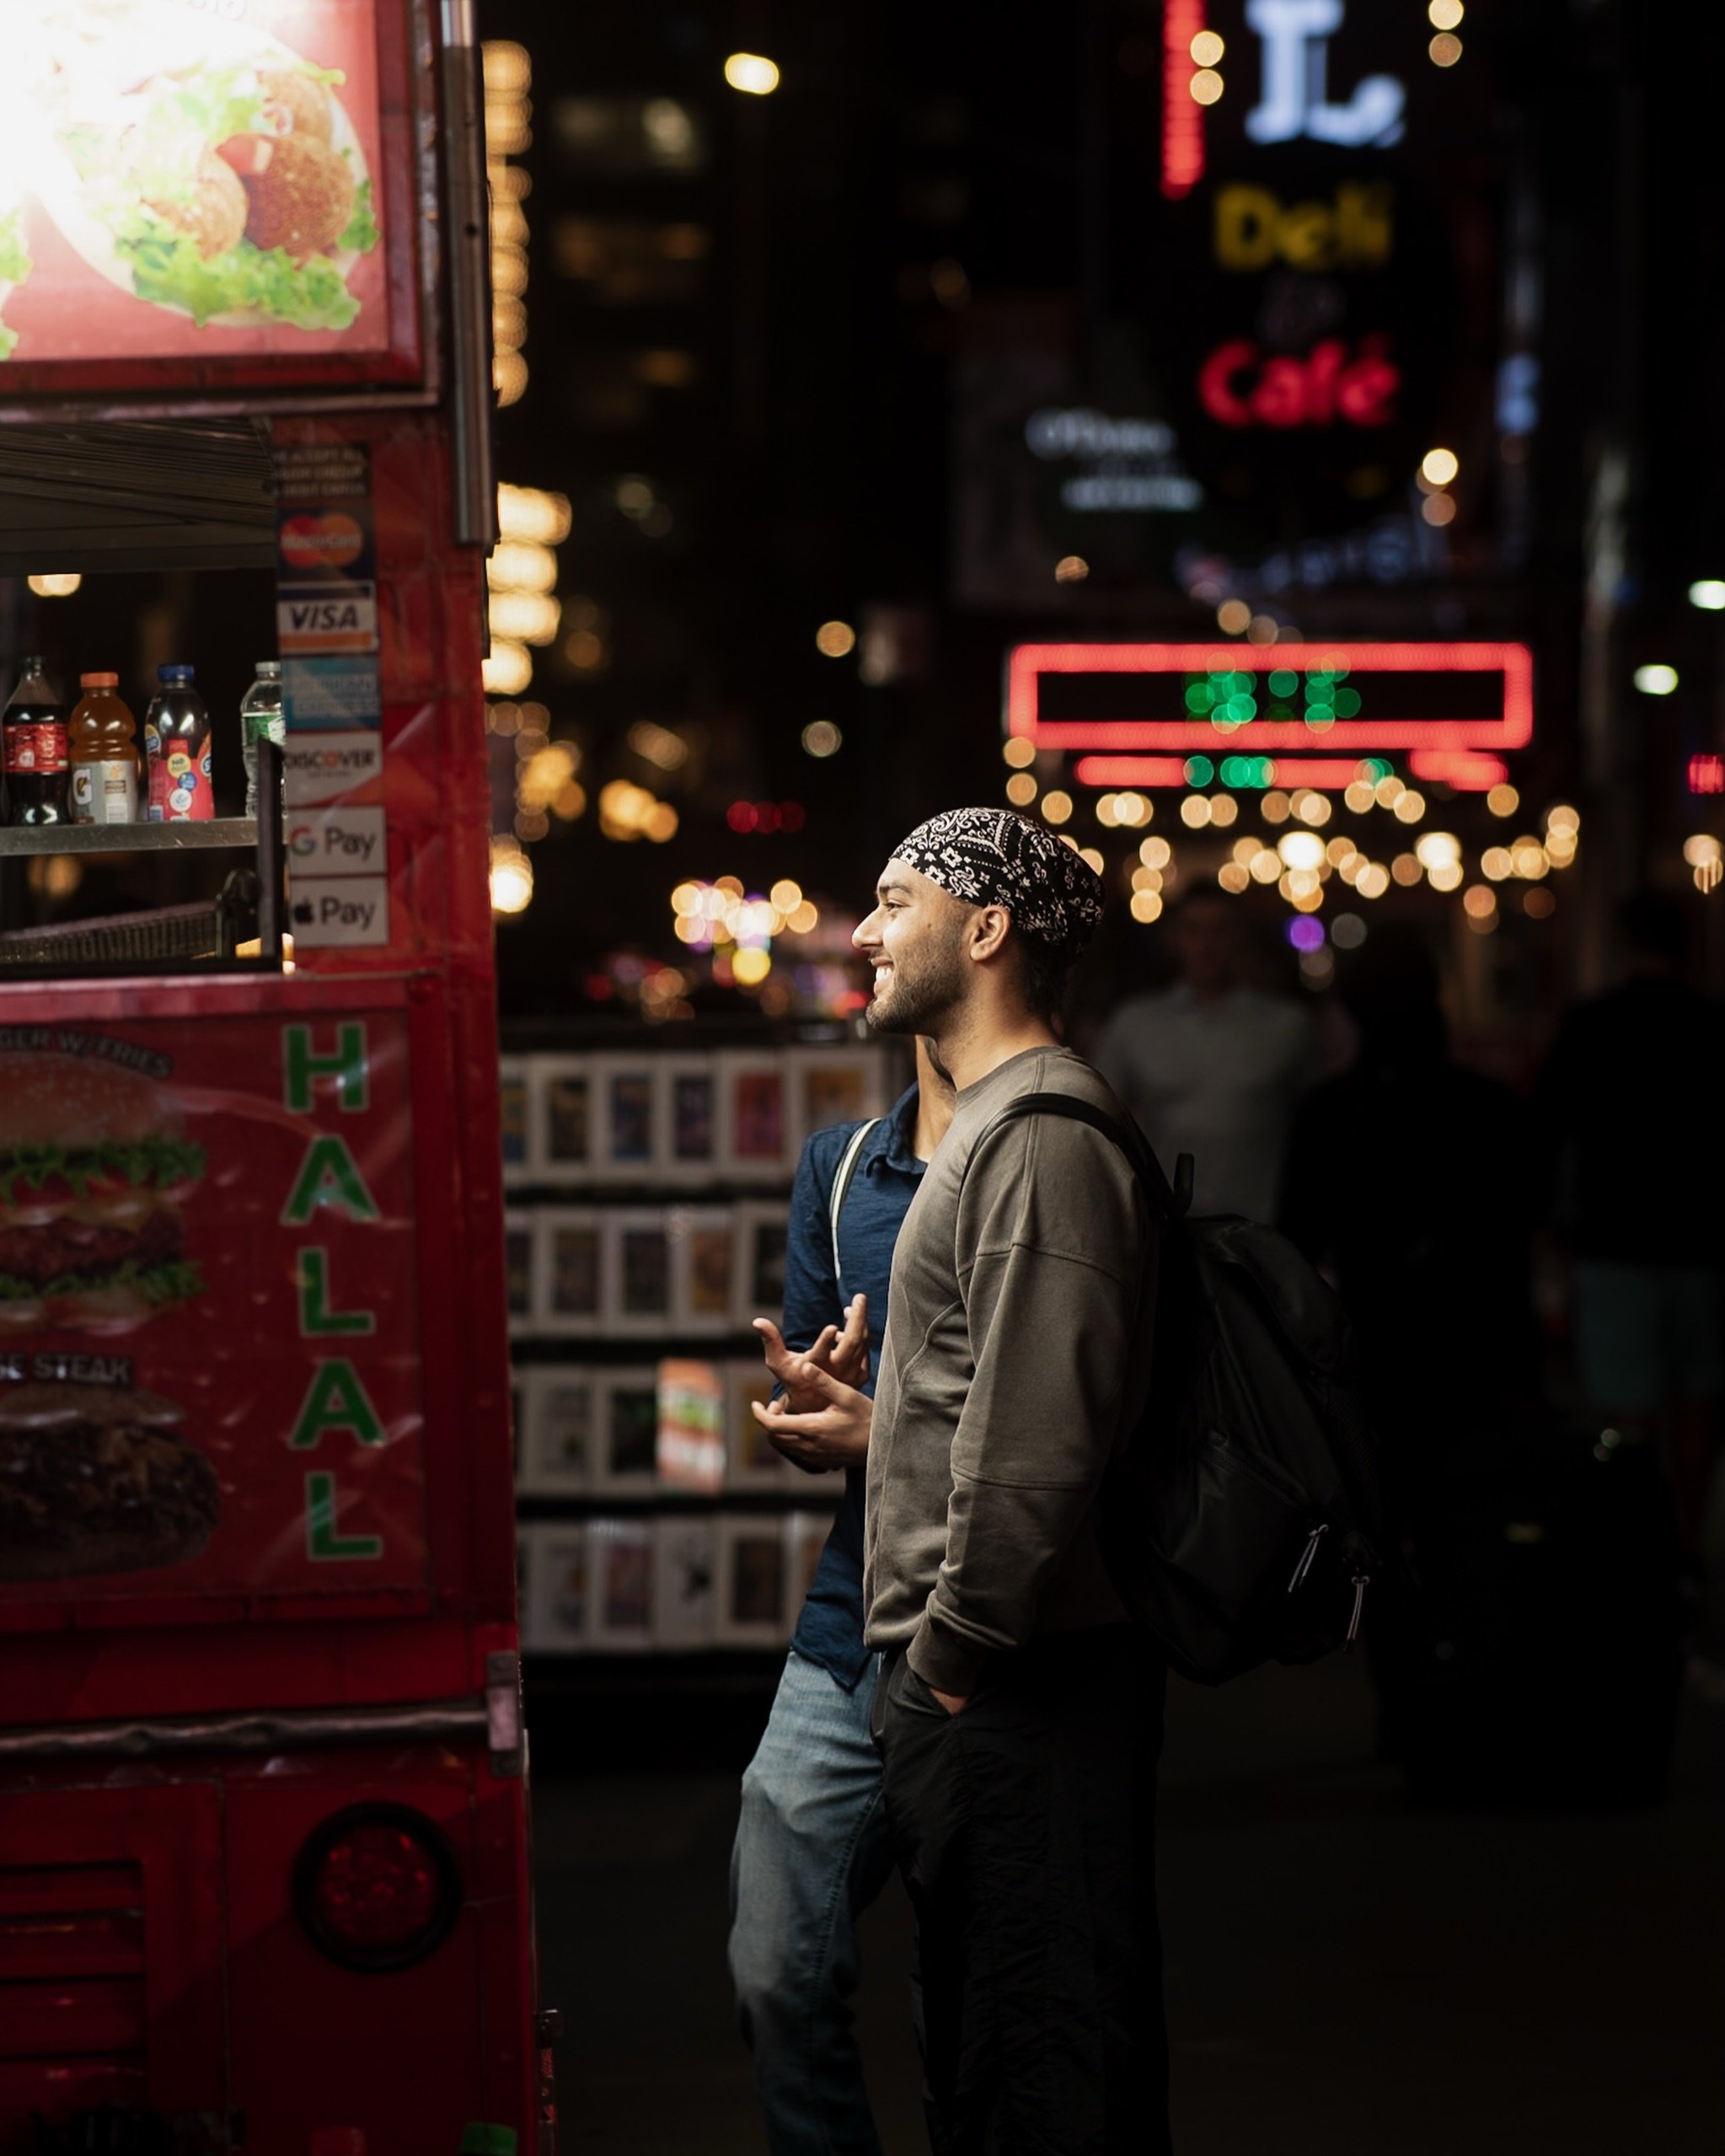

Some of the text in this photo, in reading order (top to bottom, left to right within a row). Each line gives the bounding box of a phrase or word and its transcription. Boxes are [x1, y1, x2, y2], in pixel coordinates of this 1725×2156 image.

[1213, 183, 1392, 271] Deli
[291, 604, 358, 629] VISA
[283, 749, 374, 768] DISCOVER
[72, 768, 93, 806] G
[290, 825, 377, 861] G Pay
[320, 896, 377, 932] Pay
[280, 1021, 383, 1560] HALAL
[33, 1353, 130, 1384] STEAK
